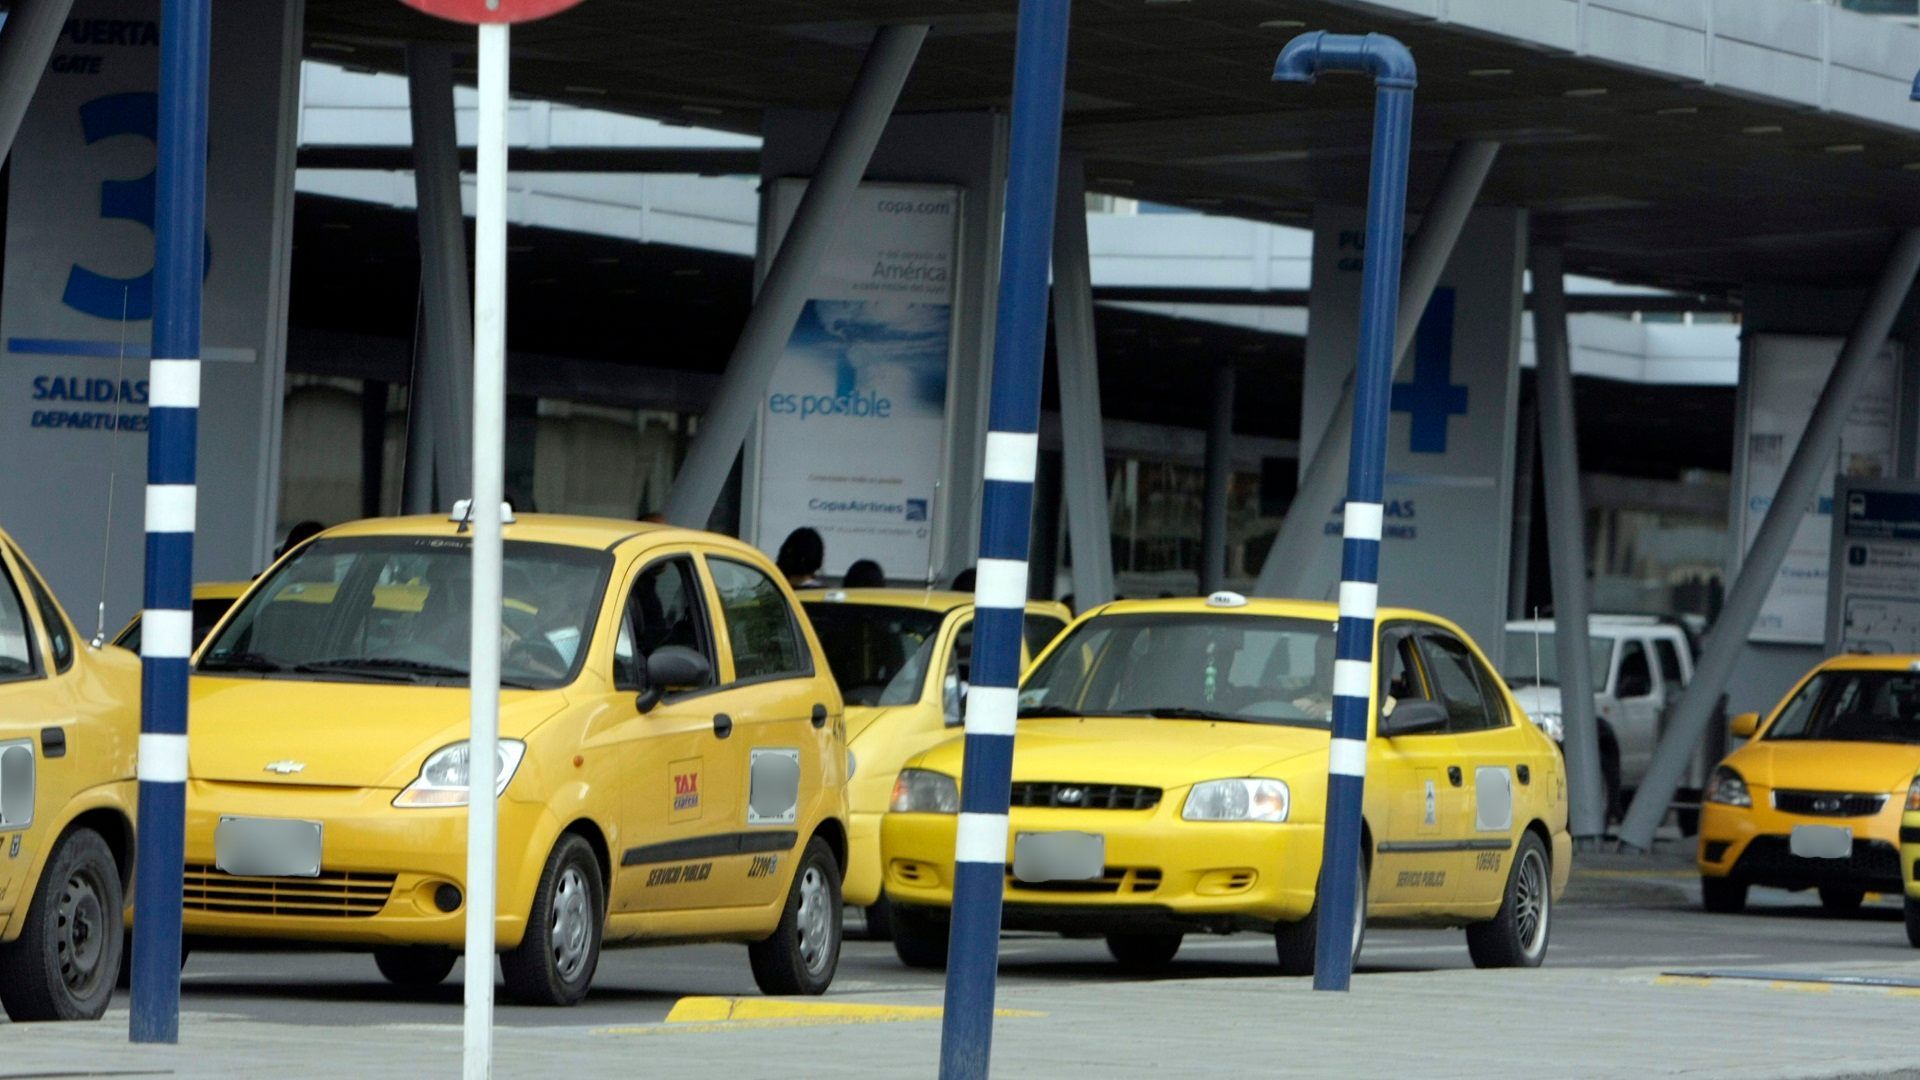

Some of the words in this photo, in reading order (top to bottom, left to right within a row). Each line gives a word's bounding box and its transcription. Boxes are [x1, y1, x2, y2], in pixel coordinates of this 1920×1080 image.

[52, 54, 103, 74] GATE
[877, 199, 950, 216] copa.com
[872, 260, 947, 282] América
[32, 376, 151, 405] SALIDAS
[768, 393, 797, 414] es
[800, 391, 892, 421] posible
[674, 773, 699, 795] TAX
[645, 866, 684, 888] SERVICIO
